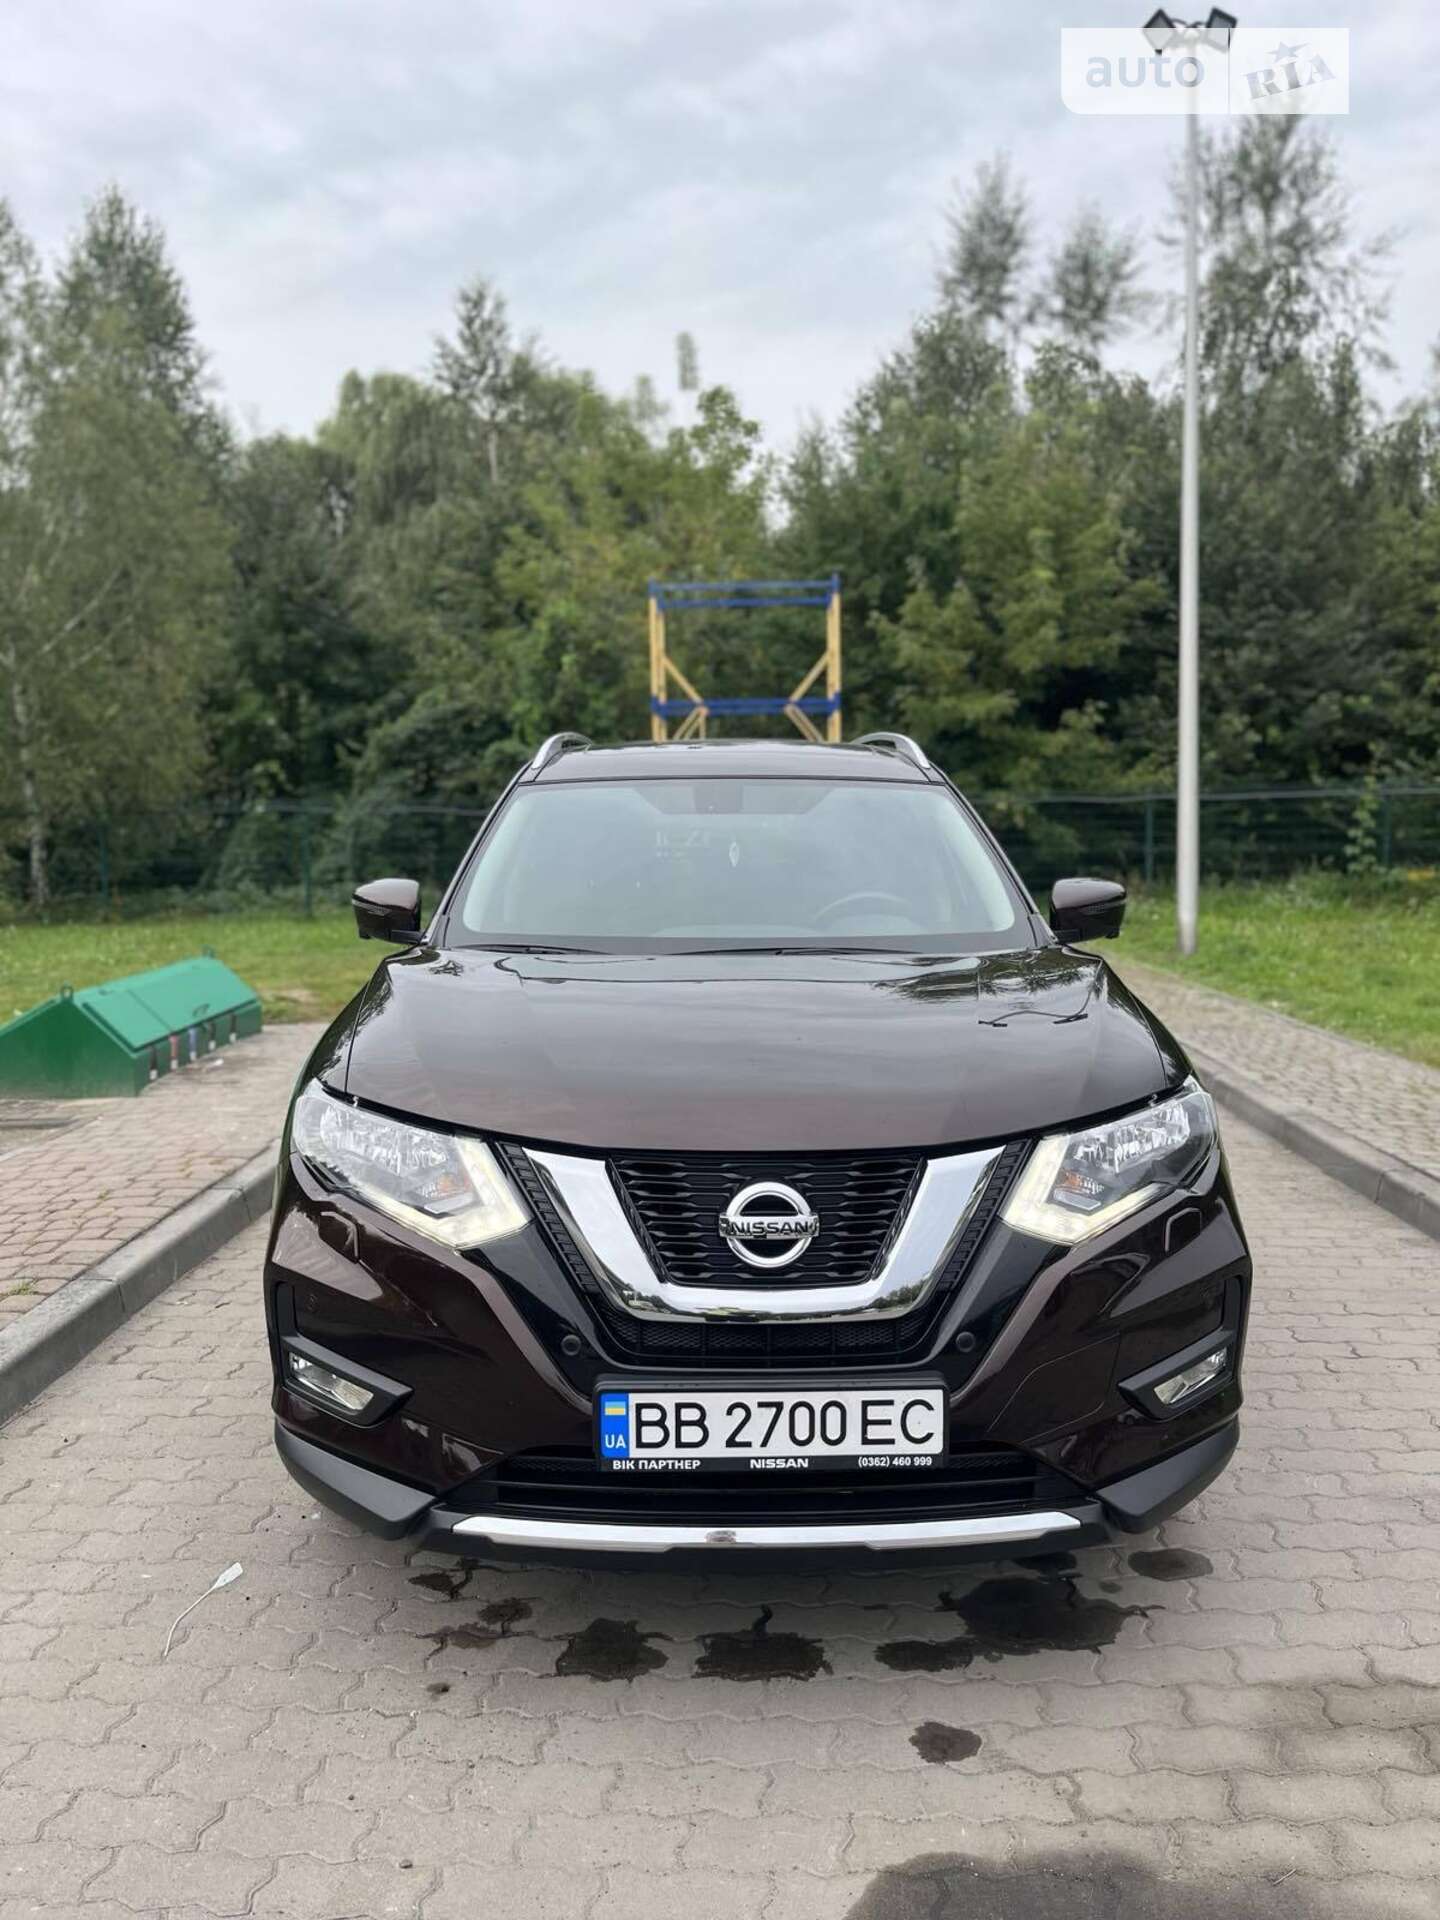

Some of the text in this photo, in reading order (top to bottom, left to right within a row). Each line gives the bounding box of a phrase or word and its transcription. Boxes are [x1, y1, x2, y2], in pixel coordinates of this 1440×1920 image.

[731, 1221, 809, 1235] NISSAN
[635, 1399, 935, 1449] BB 2700 EC
[605, 1434, 626, 1449] UA
[638, 1459, 701, 1470] ПАРТНЕР
[750, 1458, 809, 1469] NISSAN
[858, 1456, 932, 1468] (0362) 460 999
